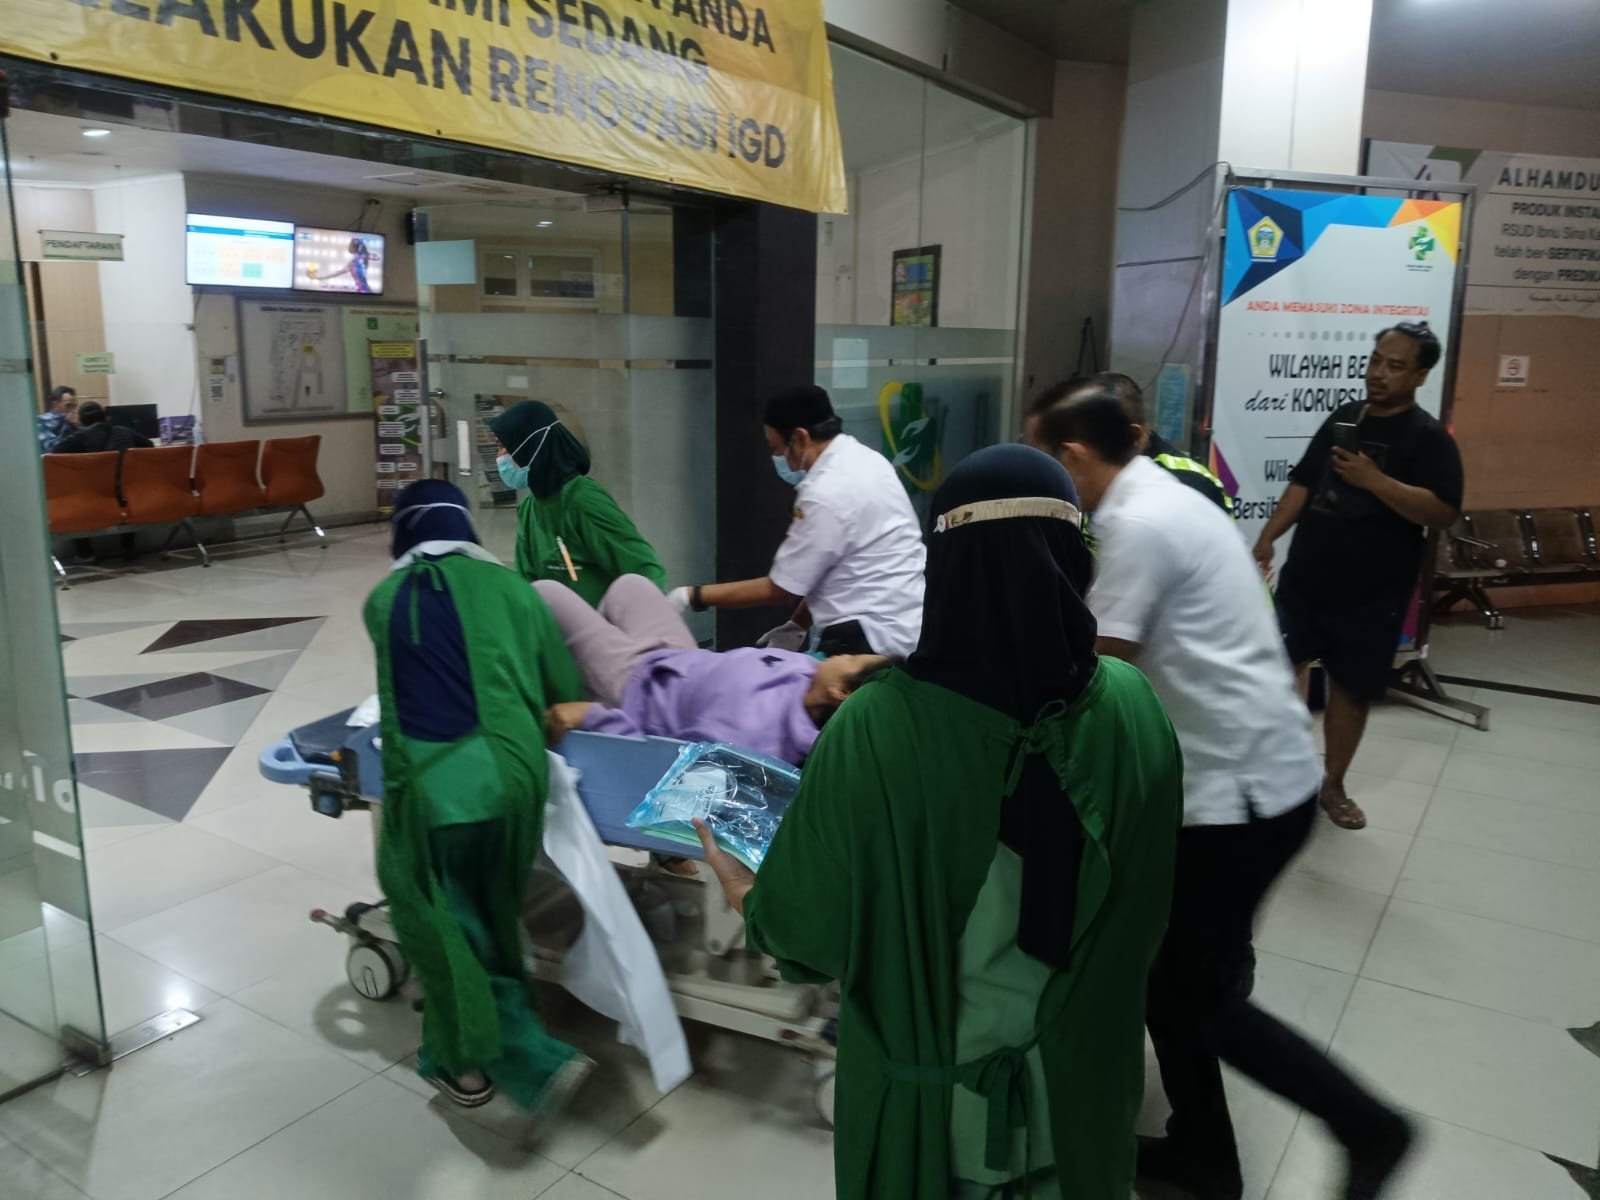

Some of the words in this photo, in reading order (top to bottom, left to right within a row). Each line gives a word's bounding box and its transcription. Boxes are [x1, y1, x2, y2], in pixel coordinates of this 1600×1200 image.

[526, 0, 709, 86] SEDANG
[488, 45, 718, 154] RENOVASI
[727, 111, 787, 169] IGD
[1511, 202, 1561, 217] PRODUK
[1269, 353, 1343, 379] WILAYAH
[1245, 389, 1289, 412] dari
